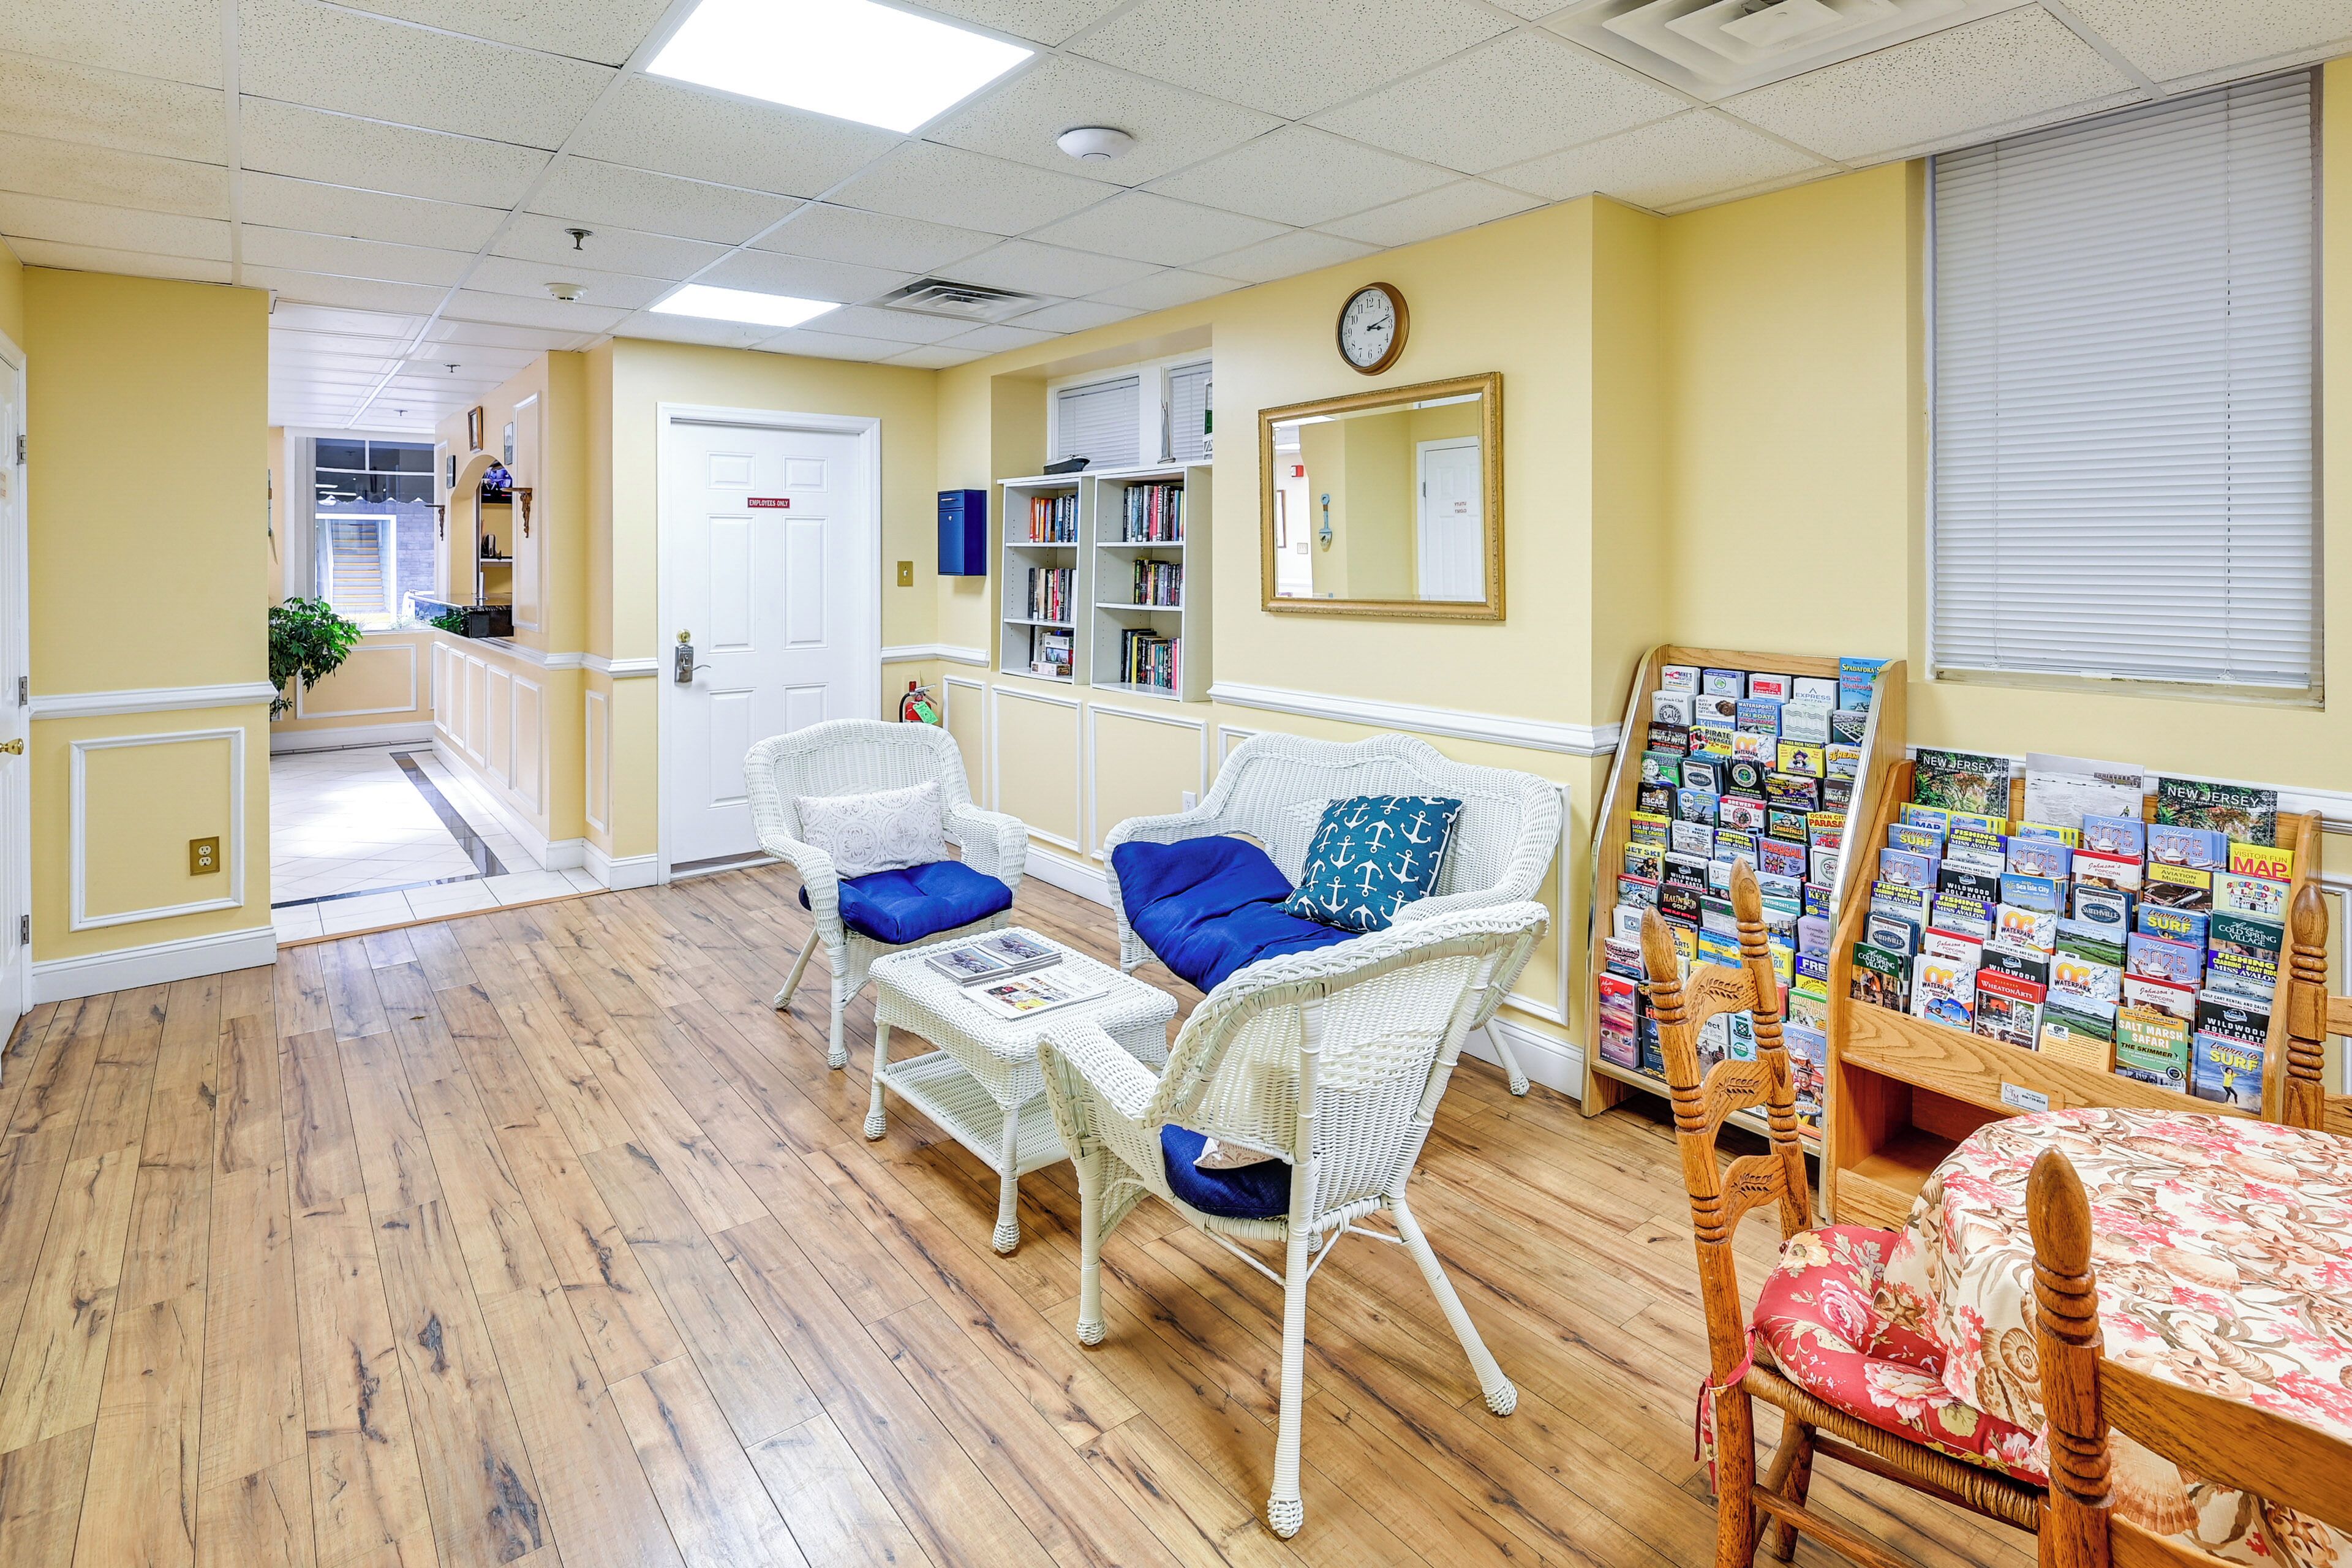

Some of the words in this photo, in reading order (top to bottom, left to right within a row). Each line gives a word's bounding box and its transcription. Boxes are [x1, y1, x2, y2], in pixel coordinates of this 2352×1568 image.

[1366, 298, 1373, 307] 12
[1378, 299, 1380, 309] 1
[1358, 304, 1363, 314] 11
[1385, 306, 1389, 316] 2
[1351, 315, 1358, 325] 10
[1389, 319, 1392, 329] 3
[1348, 328, 1352, 337] 9
[1385, 333, 1388, 342] 4
[1352, 341, 1355, 350] 8
[1378, 345, 1382, 354] 5
[1359, 348, 1362, 358] 7
[1368, 349, 1372, 359] 6
[1700, 720, 1732, 729] Kilwins
[1705, 729, 1731, 739] PIRATE
[1705, 736, 1732, 745] VOYAGES
[1923, 756, 1947, 766] NEW
[1950, 761, 1992, 772] JERSEY
[1642, 797, 1667, 806] ESCAPE
[2167, 786, 2198, 799] NEW
[2204, 792, 2259, 807] JERSEY
[1727, 799, 1755, 809] BREWERY
[1718, 831, 1749, 842] FISHING
[1899, 828, 1923, 837] Learn
[1954, 829, 1997, 841] FISHING
[2090, 826, 2133, 847] 2025
[1899, 835, 1934, 848] SURF
[1970, 843, 1999, 852] AVALON
[2155, 835, 2203, 856] 2025
[1762, 841, 1804, 859] PARASAIL
[2234, 850, 2267, 860] VISITOR
[2016, 850, 2058, 870] 2025
[1885, 860, 1921, 881] 2025
[2234, 856, 2287, 878] MAP
[1670, 872, 1702, 883] WILDWOOD
[2161, 870, 2196, 880] AVIATION
[2162, 875, 2195, 885] MUSEUM
[1877, 883, 1918, 895] FISHING
[1947, 882, 1989, 896] WILDWOOD
[2227, 882, 2283, 898] STORYBOOK
[2241, 889, 2267, 898] LAND
[1663, 893, 1697, 909] HAUNTED
[1893, 897, 1920, 907] AVALON
[1940, 895, 1983, 908] FISHING
[1967, 892, 1991, 902] CARTS
[1956, 910, 1985, 919] AVALON
[2082, 906, 2119, 919] SMITHVILLE
[2147, 909, 2179, 920] Learn
[2003, 911, 2035, 933] OC
[2147, 916, 2192, 934] SURF
[1874, 933, 1904, 946] SMITHVILLE
[2001, 927, 2035, 941] WATERPARK
[2218, 925, 2243, 935] COLD
[2245, 931, 2276, 943] SPRING
[2230, 933, 2266, 947] VILLAGE
[1803, 959, 1828, 972] FRE
[1858, 952, 1875, 962] COLD
[1877, 958, 1894, 969] SPRING
[1865, 960, 1889, 972] VILLAGE
[2138, 948, 2187, 973] 2025
[2213, 958, 2241, 969] CRABBING
[2218, 952, 2275, 970] FISHING
[1989, 964, 2035, 981] WILDWOOD
[2214, 965, 2239, 974] MISS
[2240, 970, 2277, 982] AVALON
[1922, 982, 1955, 995] WATERPARK
[2054, 979, 2092, 993] WATERPARK
[2147, 993, 2174, 1003] POPCORN
[2119, 1020, 2143, 1032] SALT
[2146, 1025, 2183, 1041] MARSH
[2207, 1017, 2265, 1036] WILDWOOD
[2005, 1033, 2032, 1045] experience
[2204, 1024, 2230, 1035] GOLF
[2234, 1032, 2266, 1044] CARTS
[2132, 1033, 2169, 1049] SAFARI
[2137, 1046, 2173, 1058] SKIMMER
[2210, 1042, 2244, 1056] Learn
[2209, 1050, 2258, 1071] SURF
